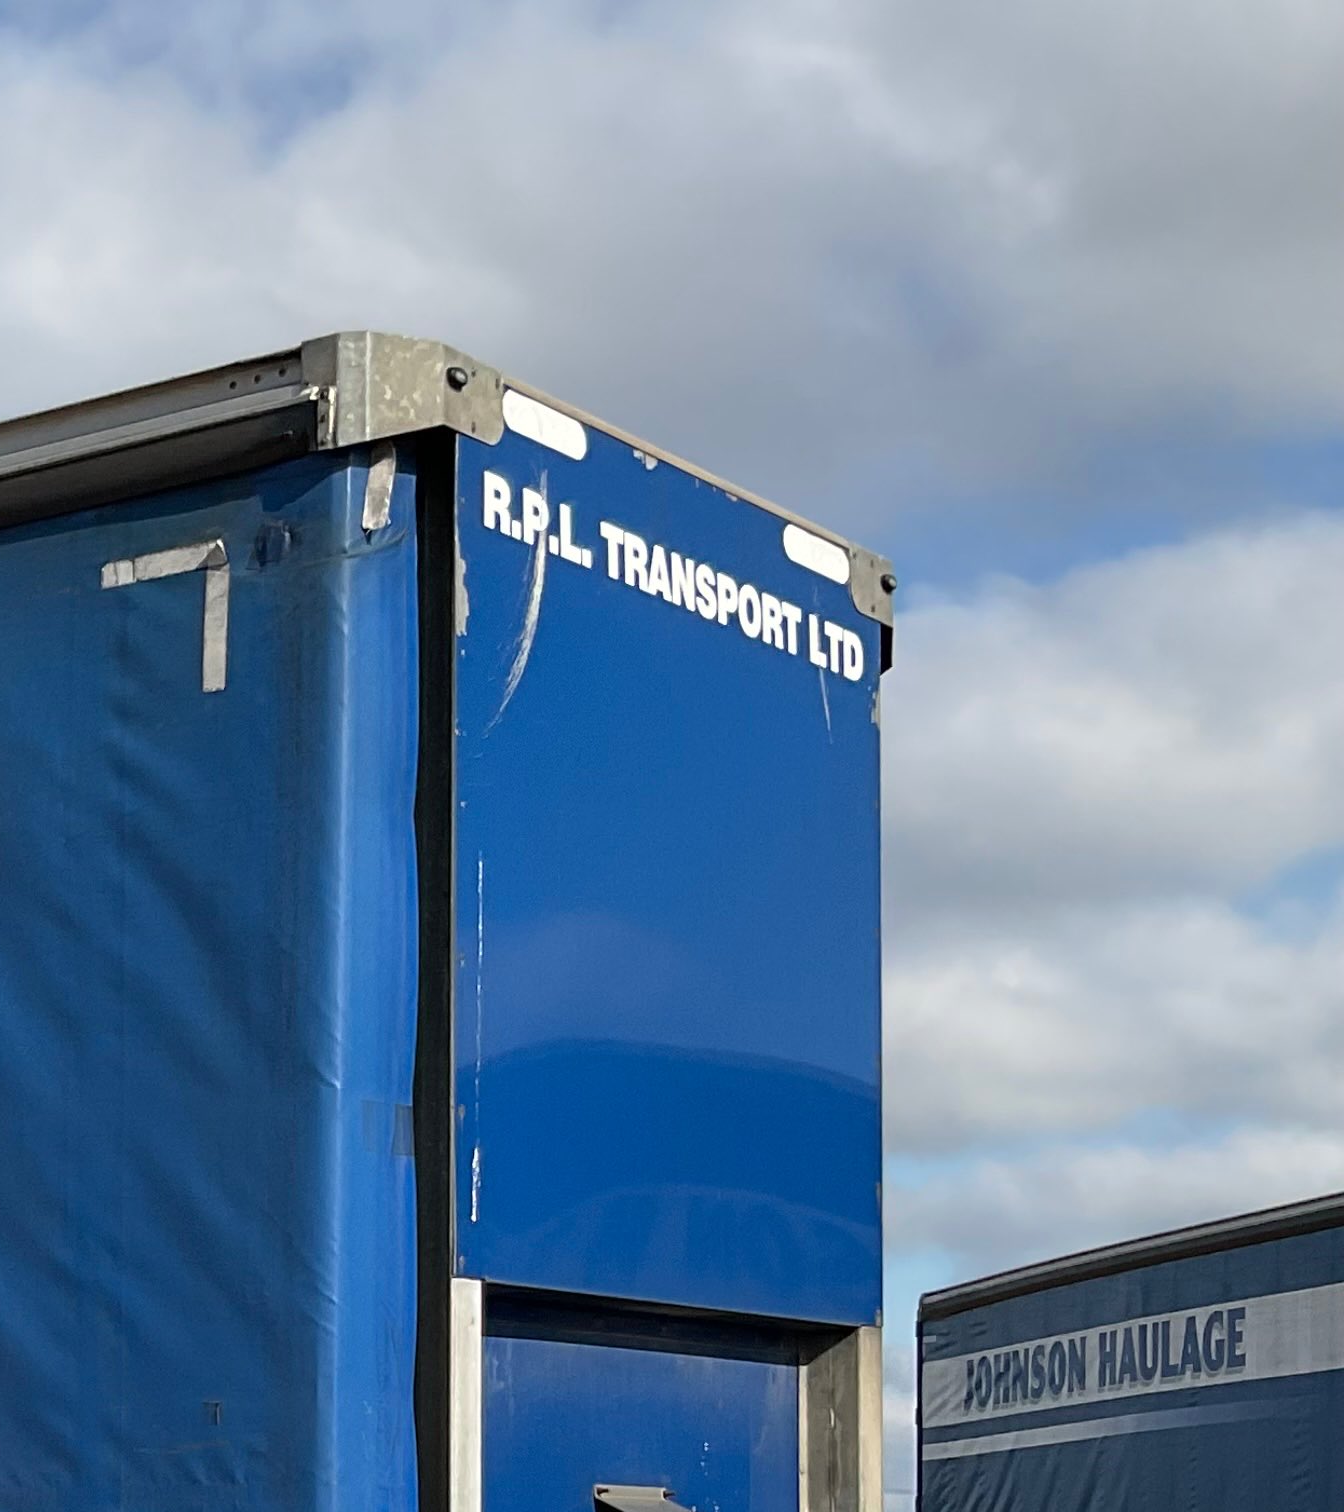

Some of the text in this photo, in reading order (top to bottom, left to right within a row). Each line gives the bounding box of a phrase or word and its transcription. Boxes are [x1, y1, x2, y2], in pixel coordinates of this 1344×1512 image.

[482, 470, 865, 682] R.P.L. TRANSPORT LTD
[963, 1306, 1247, 1415] JOHNSON HAULAGE
